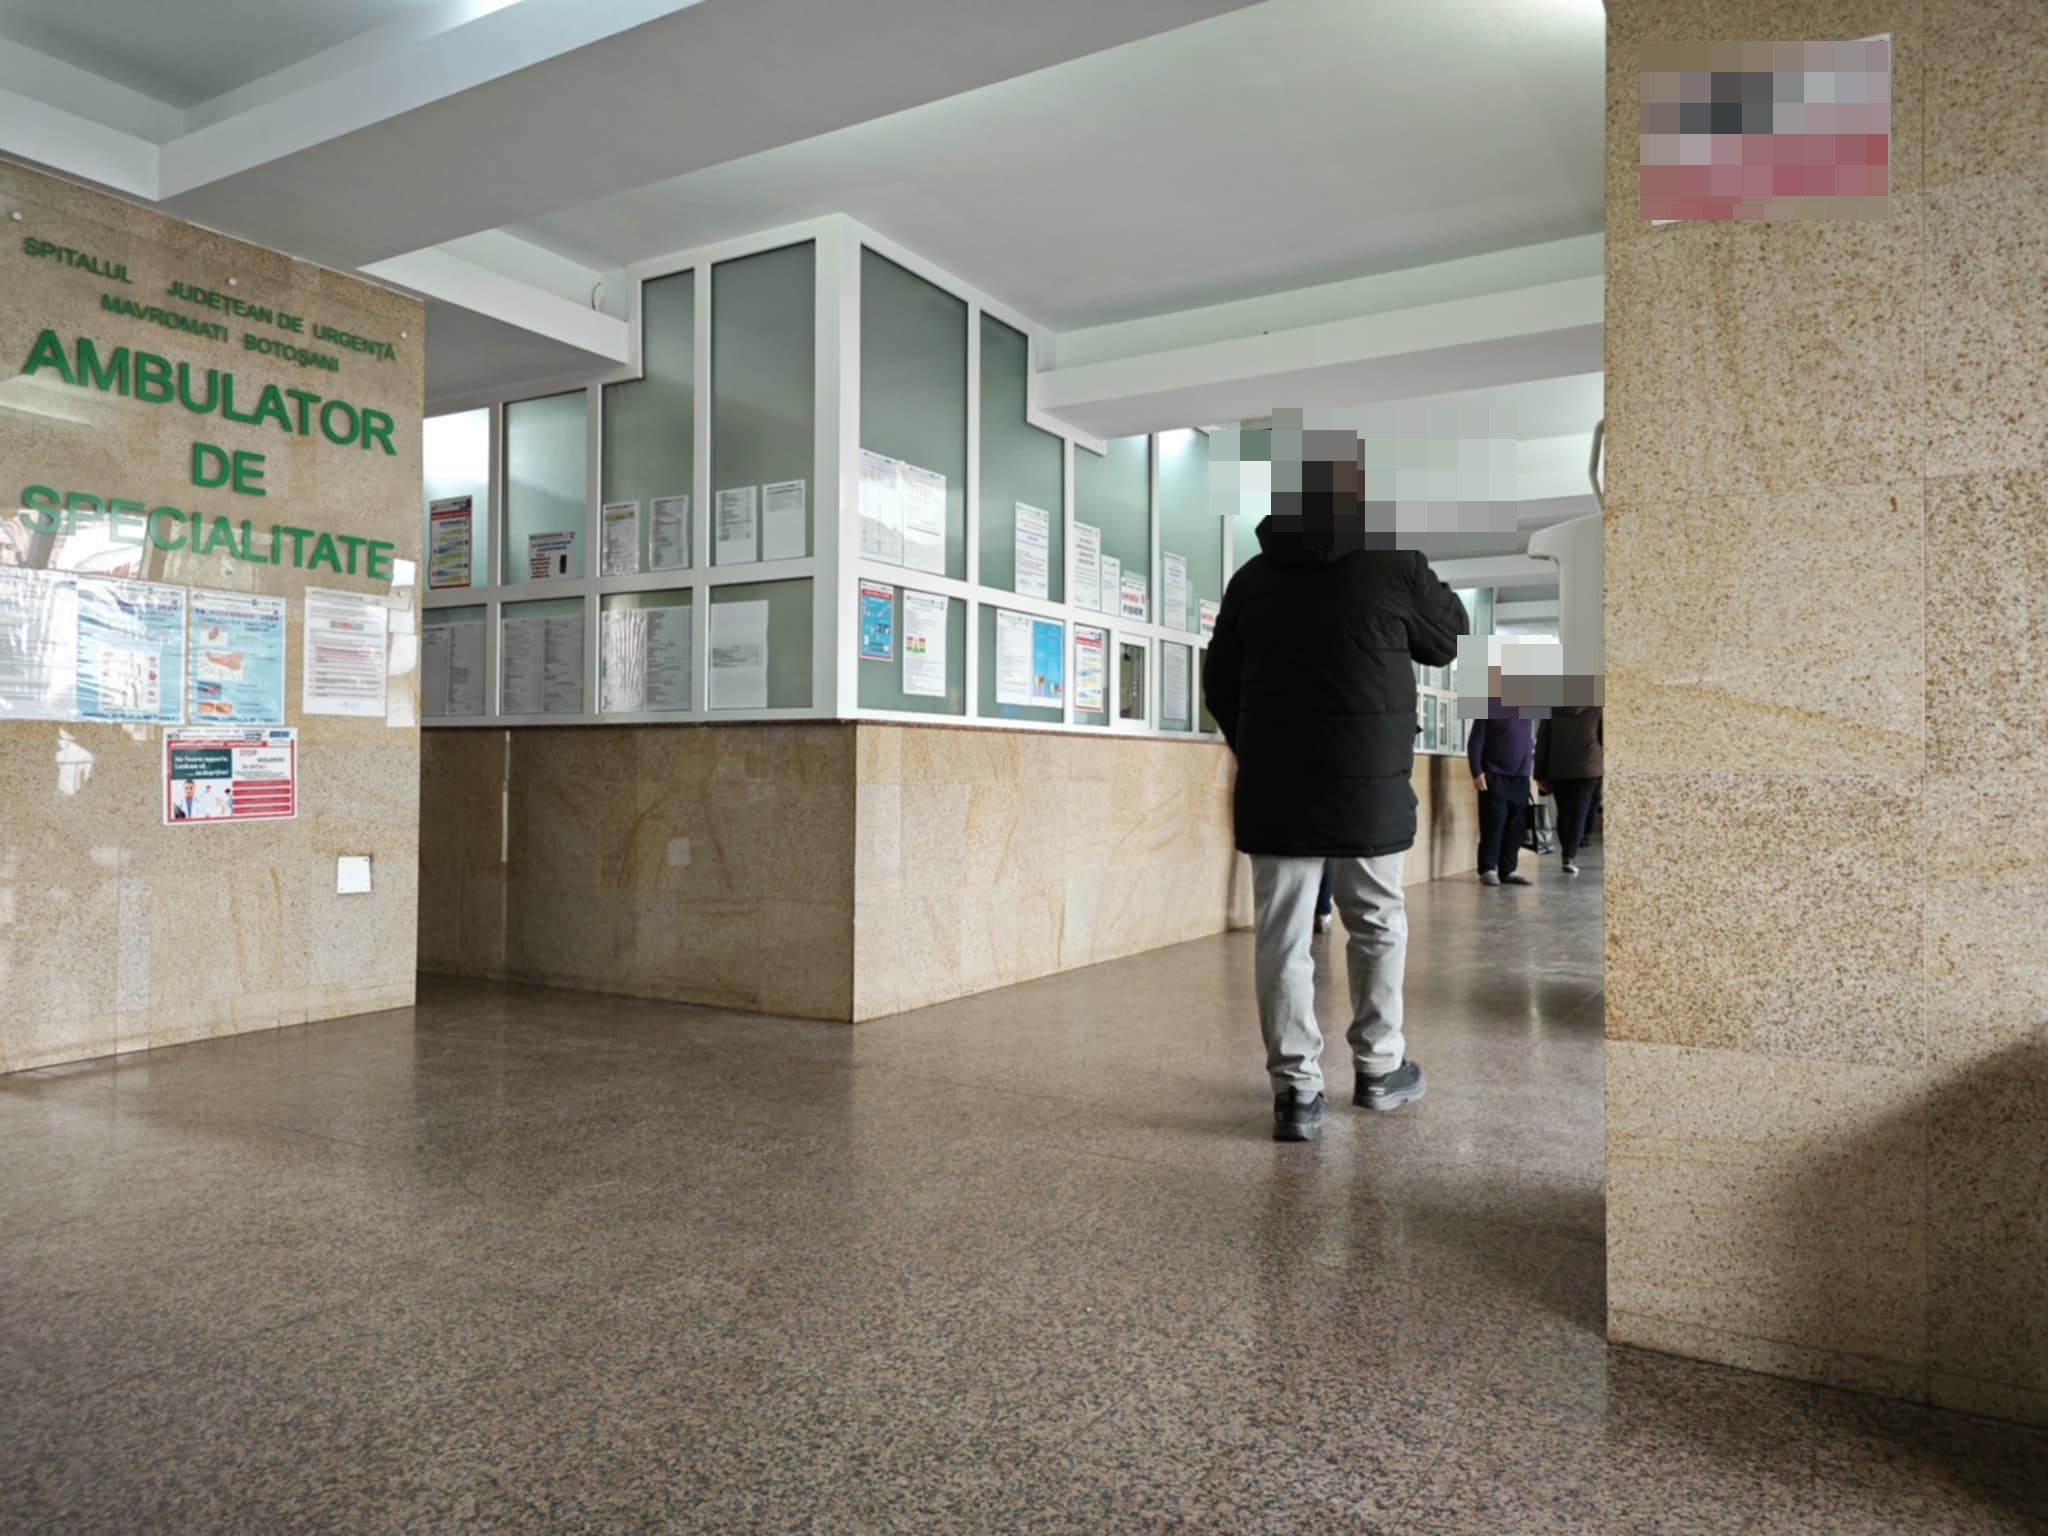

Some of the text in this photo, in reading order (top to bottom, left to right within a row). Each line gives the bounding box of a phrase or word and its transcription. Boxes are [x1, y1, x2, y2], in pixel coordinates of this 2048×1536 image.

[24, 236, 133, 284] SPITALUL
[277, 311, 305, 335] DE
[101, 293, 229, 343] MAVROMATI
[22, 328, 397, 456] AMBULATOR
[192, 441, 266, 496] DE
[19, 484, 394, 581] SPECIALITATE
